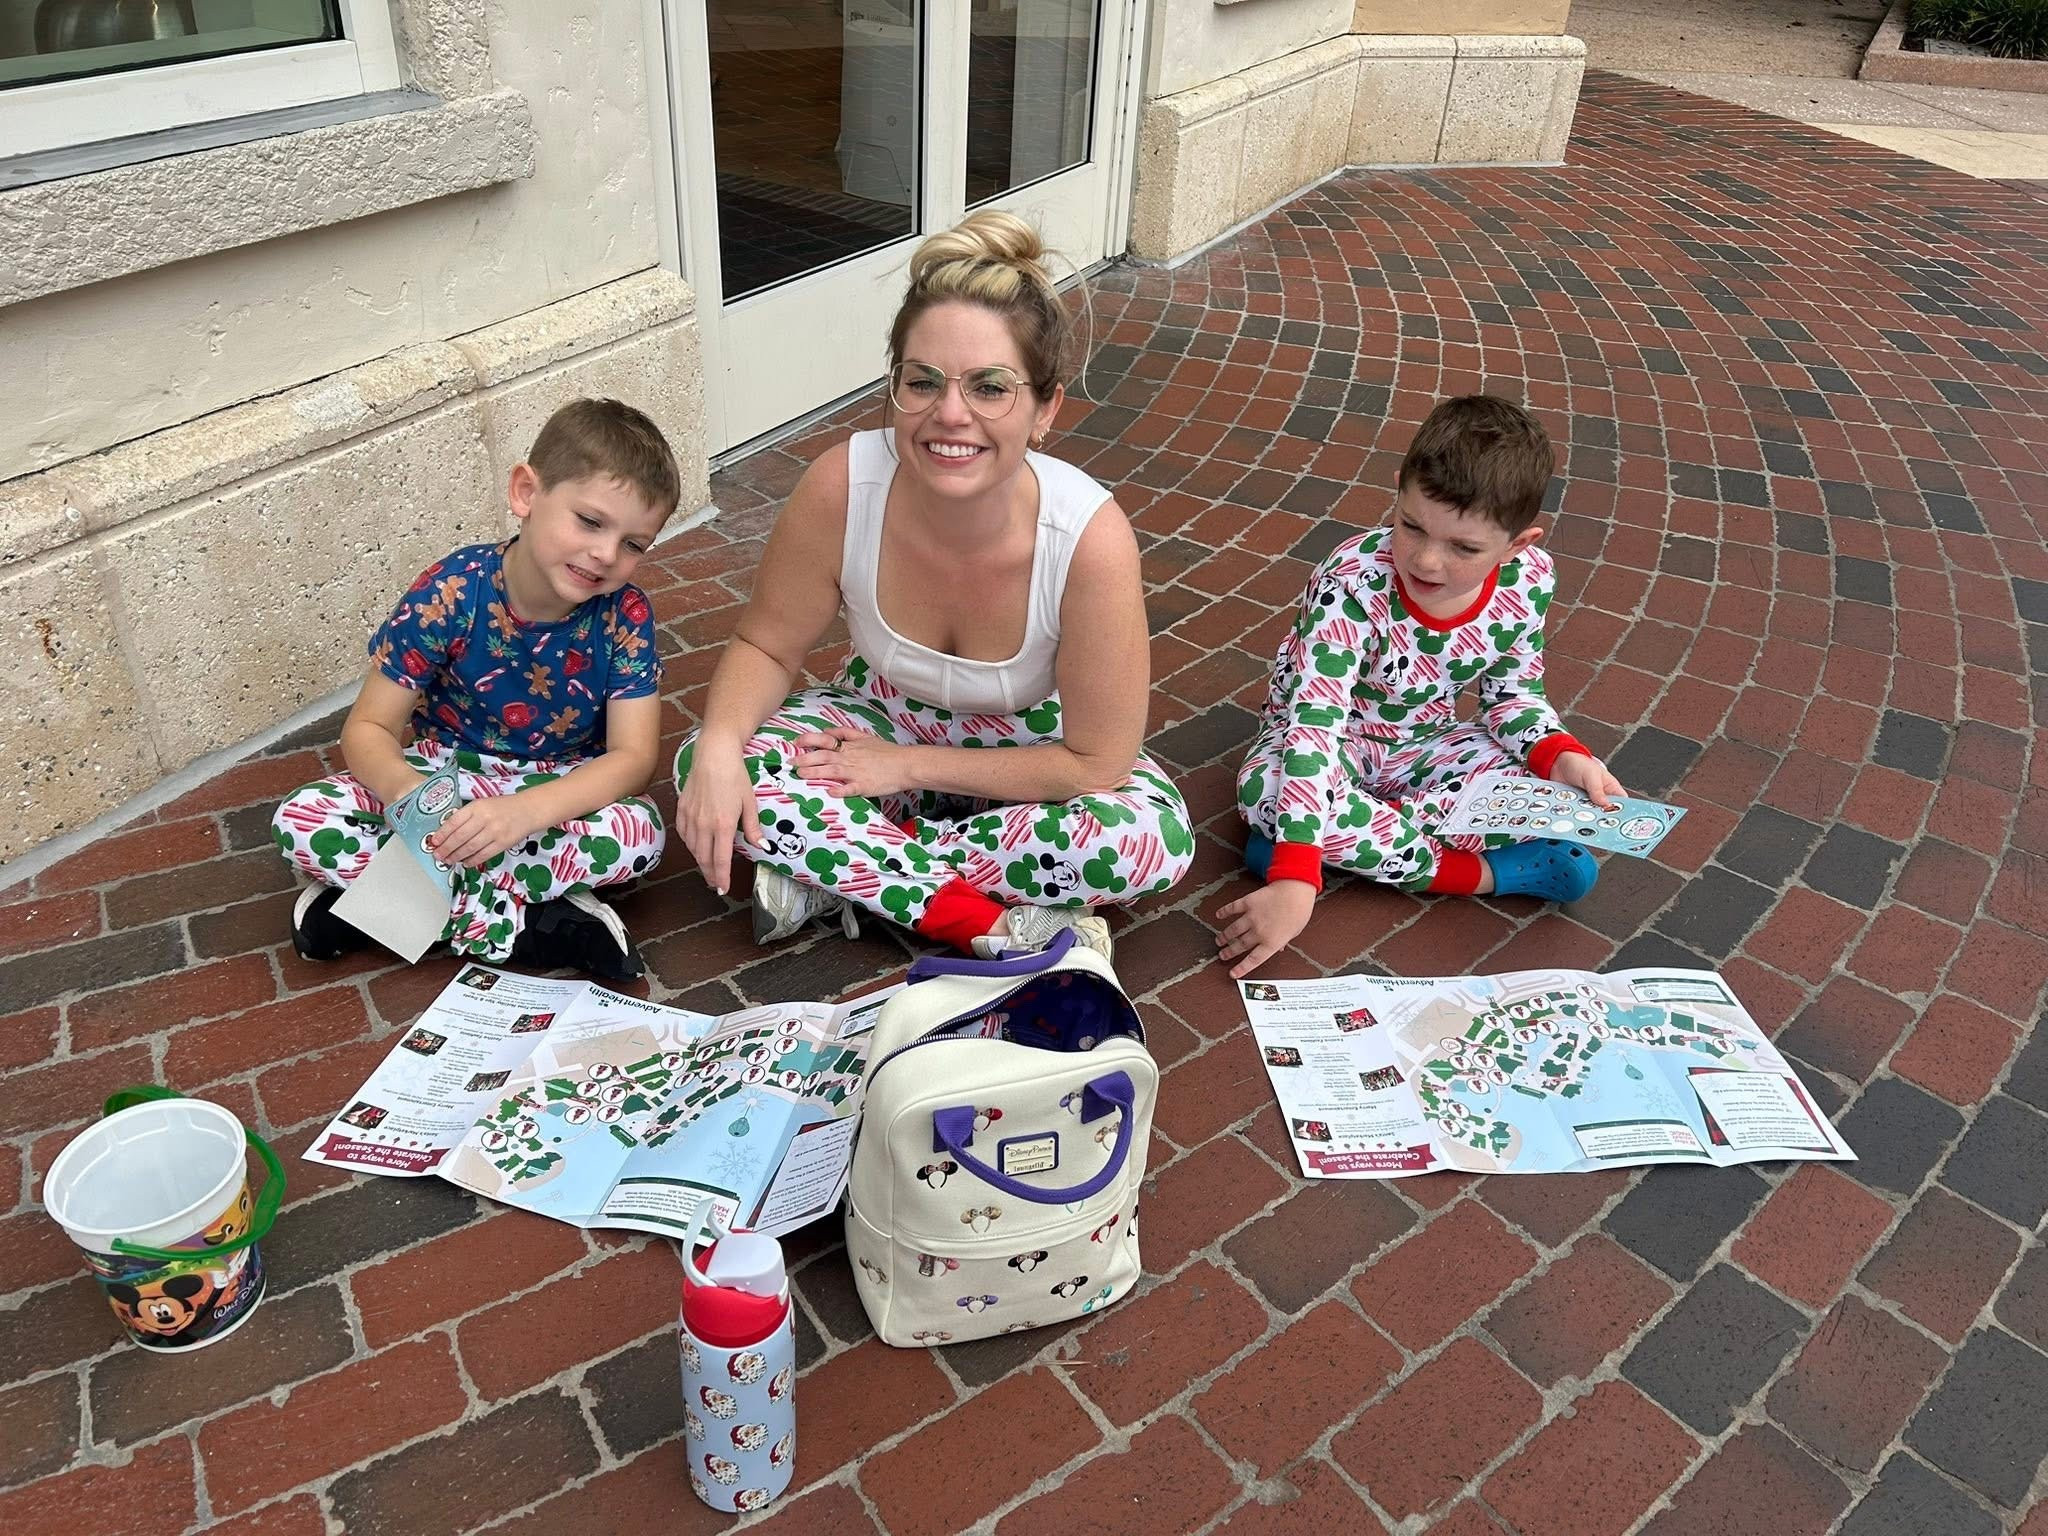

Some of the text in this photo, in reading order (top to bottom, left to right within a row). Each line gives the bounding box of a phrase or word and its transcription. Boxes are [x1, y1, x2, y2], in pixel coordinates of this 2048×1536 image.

[1365, 977, 1434, 987] AdventHealth
[588, 985, 662, 1014] AdventHealth
[333, 1143, 433, 1163] Celebrate the Season!
[346, 1152, 411, 1169] More ways to
[1318, 1152, 1420, 1165] Celebrate the Season!
[1337, 1160, 1402, 1171] More ways to
